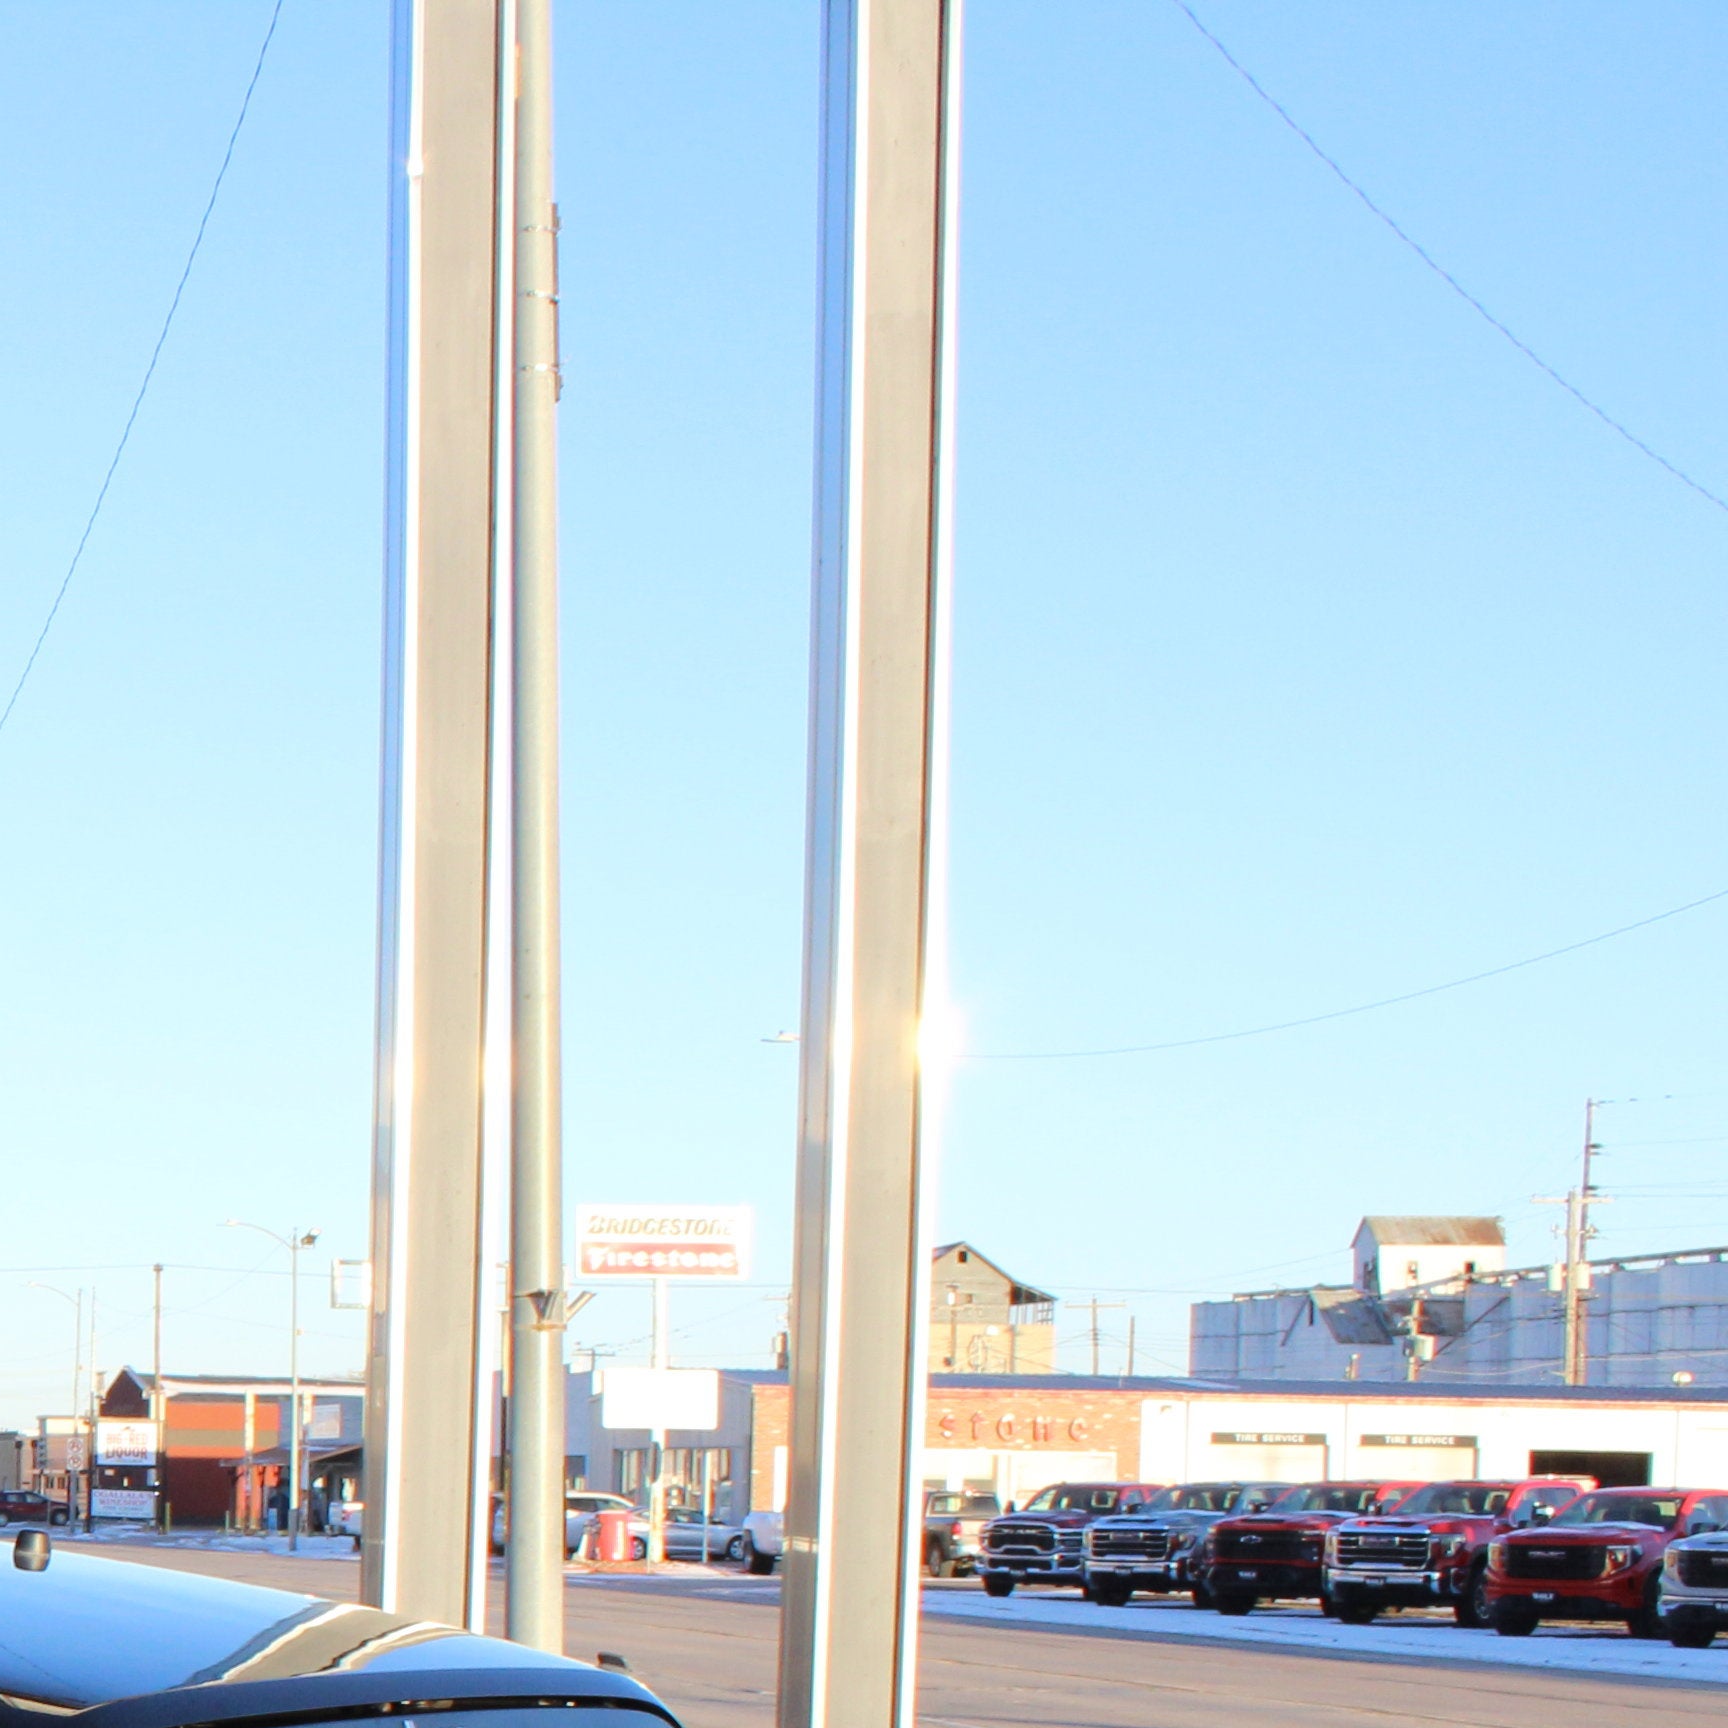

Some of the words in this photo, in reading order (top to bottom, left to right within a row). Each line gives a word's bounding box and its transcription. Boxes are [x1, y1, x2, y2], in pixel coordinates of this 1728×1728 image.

[587, 1215, 735, 1236] BRIDGESTONE
[585, 1246, 736, 1271] Firestone
[1235, 1433, 1258, 1443] TIRE
[1262, 1433, 1306, 1443] SERVICE
[1384, 1435, 1407, 1445] TIRE
[1411, 1436, 1456, 1445] SERVICE
[105, 1446, 149, 1460] LIQUOR
